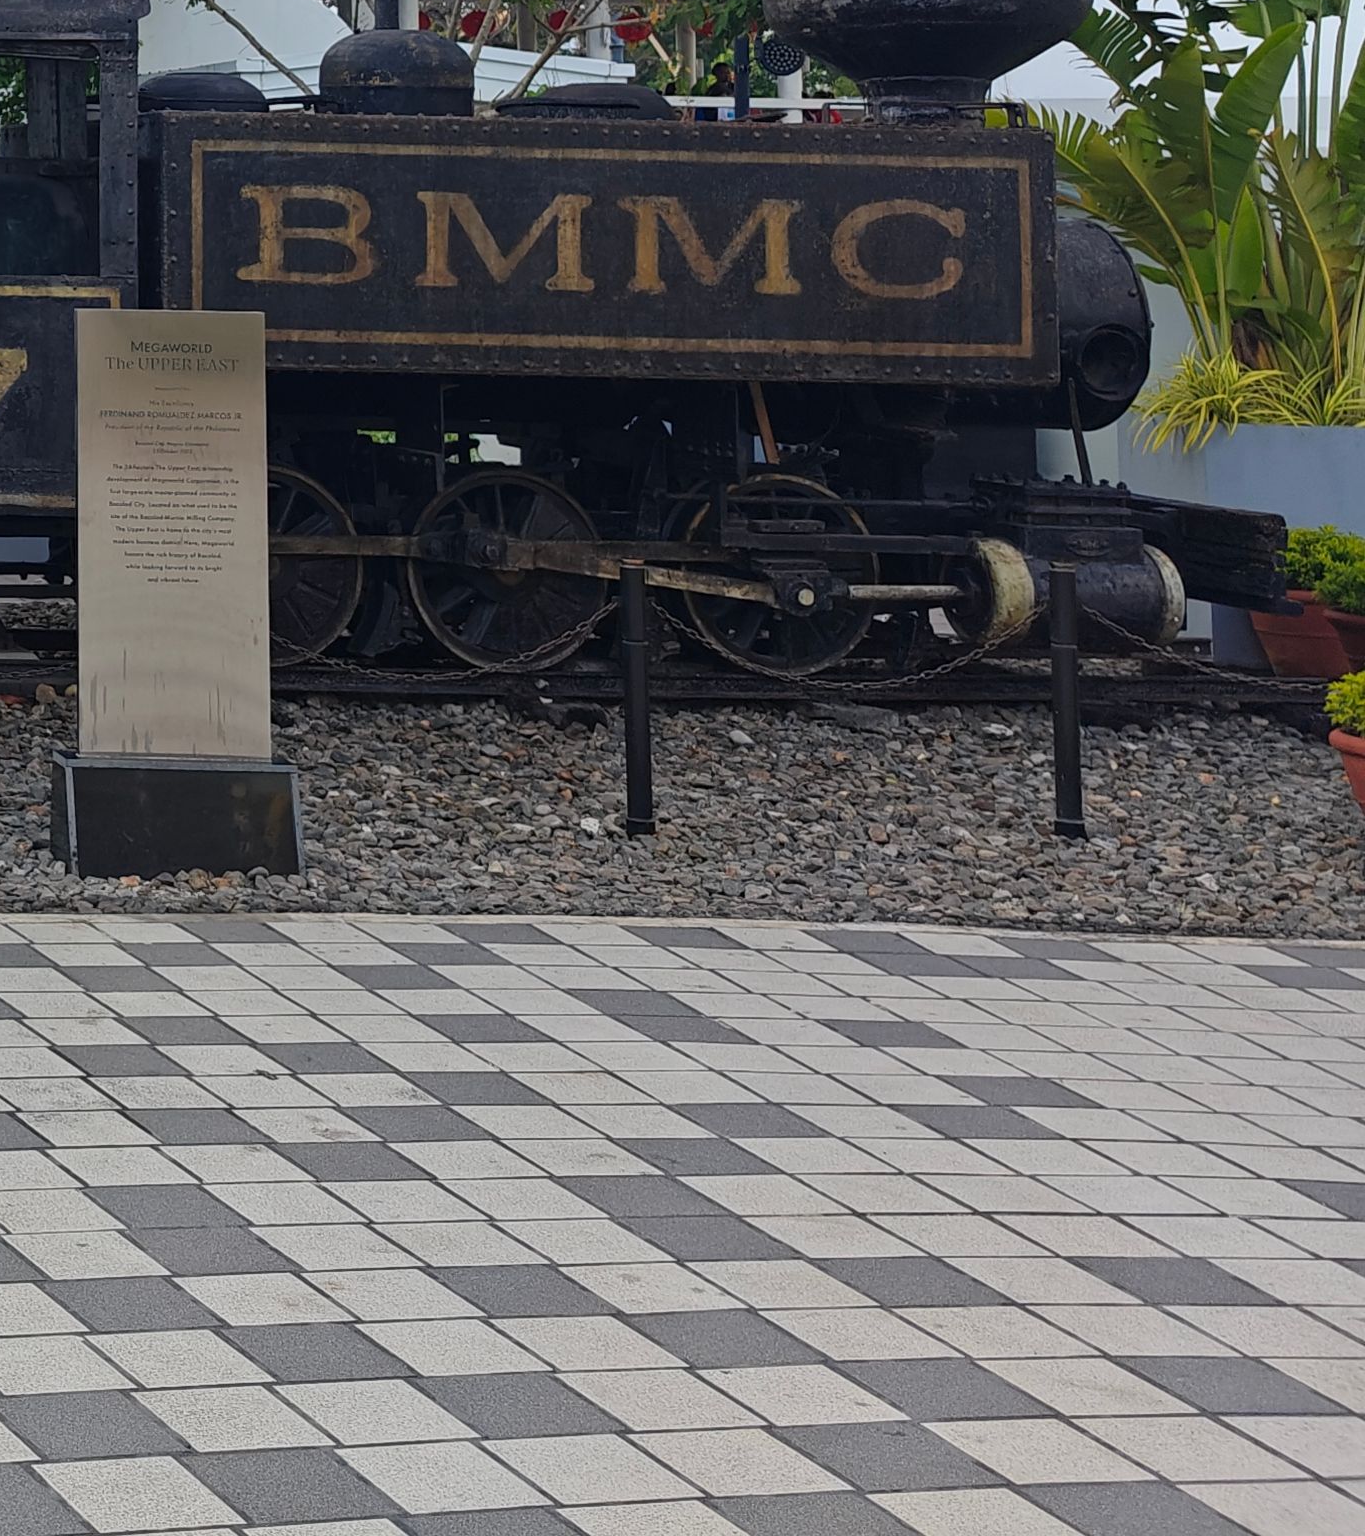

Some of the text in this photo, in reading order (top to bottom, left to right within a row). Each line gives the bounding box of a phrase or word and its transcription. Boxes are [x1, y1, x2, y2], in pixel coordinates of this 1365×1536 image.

[235, 183, 967, 300] BMMC
[105, 356, 240, 372] The UPPER EAST
